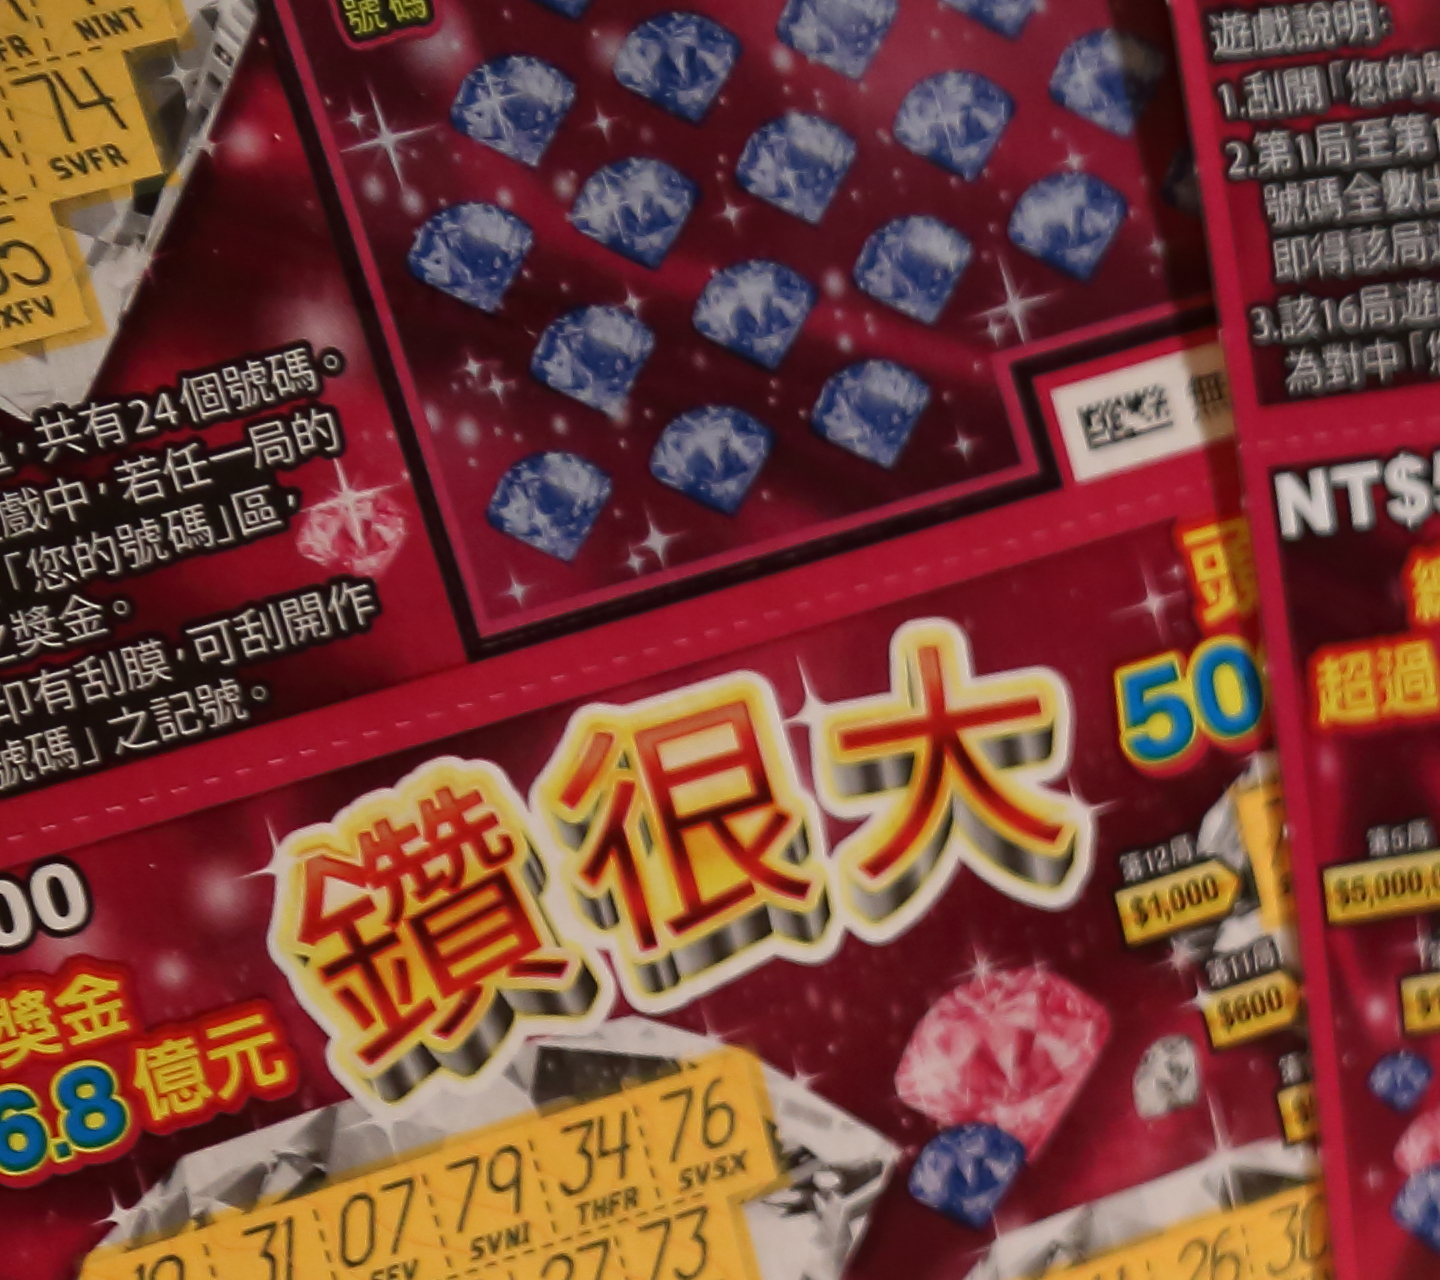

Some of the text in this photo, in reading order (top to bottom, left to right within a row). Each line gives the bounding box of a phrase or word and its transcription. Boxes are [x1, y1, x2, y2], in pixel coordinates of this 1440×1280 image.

[11, 67, 128, 143] 74
[50, 142, 129, 181] SVFR
[285, 630, 1082, 1085] 鑽很大
[1130, 876, 1220, 928] $1,000
[339, 1178, 415, 1270] 07
[447, 1144, 524, 1234] 79
[560, 1112, 633, 1196] 34
[661, 1076, 736, 1165] 76
